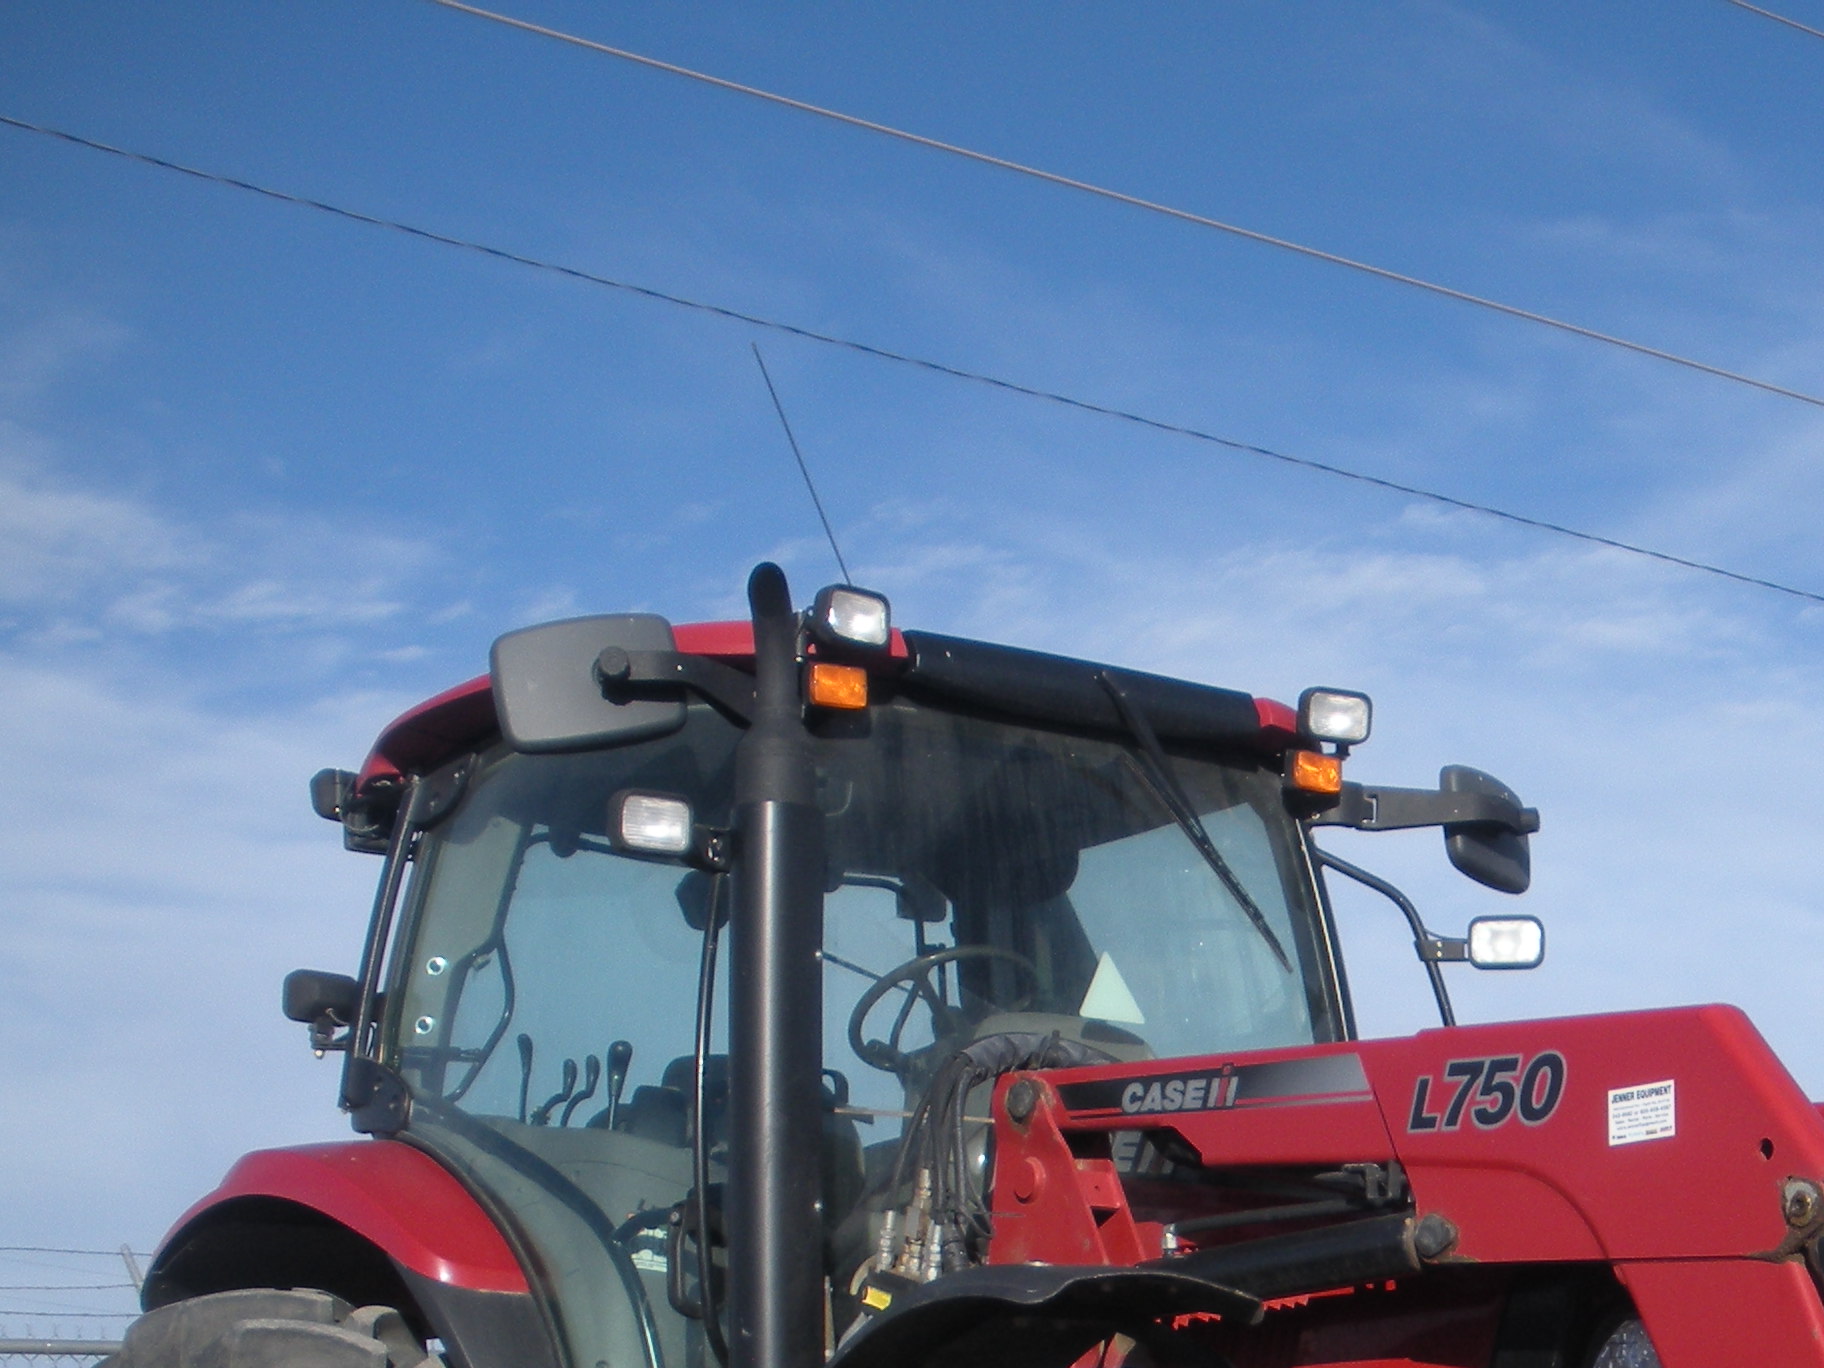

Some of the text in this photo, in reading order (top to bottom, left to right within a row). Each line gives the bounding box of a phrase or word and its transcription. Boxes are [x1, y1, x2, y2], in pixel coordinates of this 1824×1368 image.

[1407, 1050, 1568, 1133] L750
[1611, 1084, 1672, 1105] JENNER EQUIPMENT
